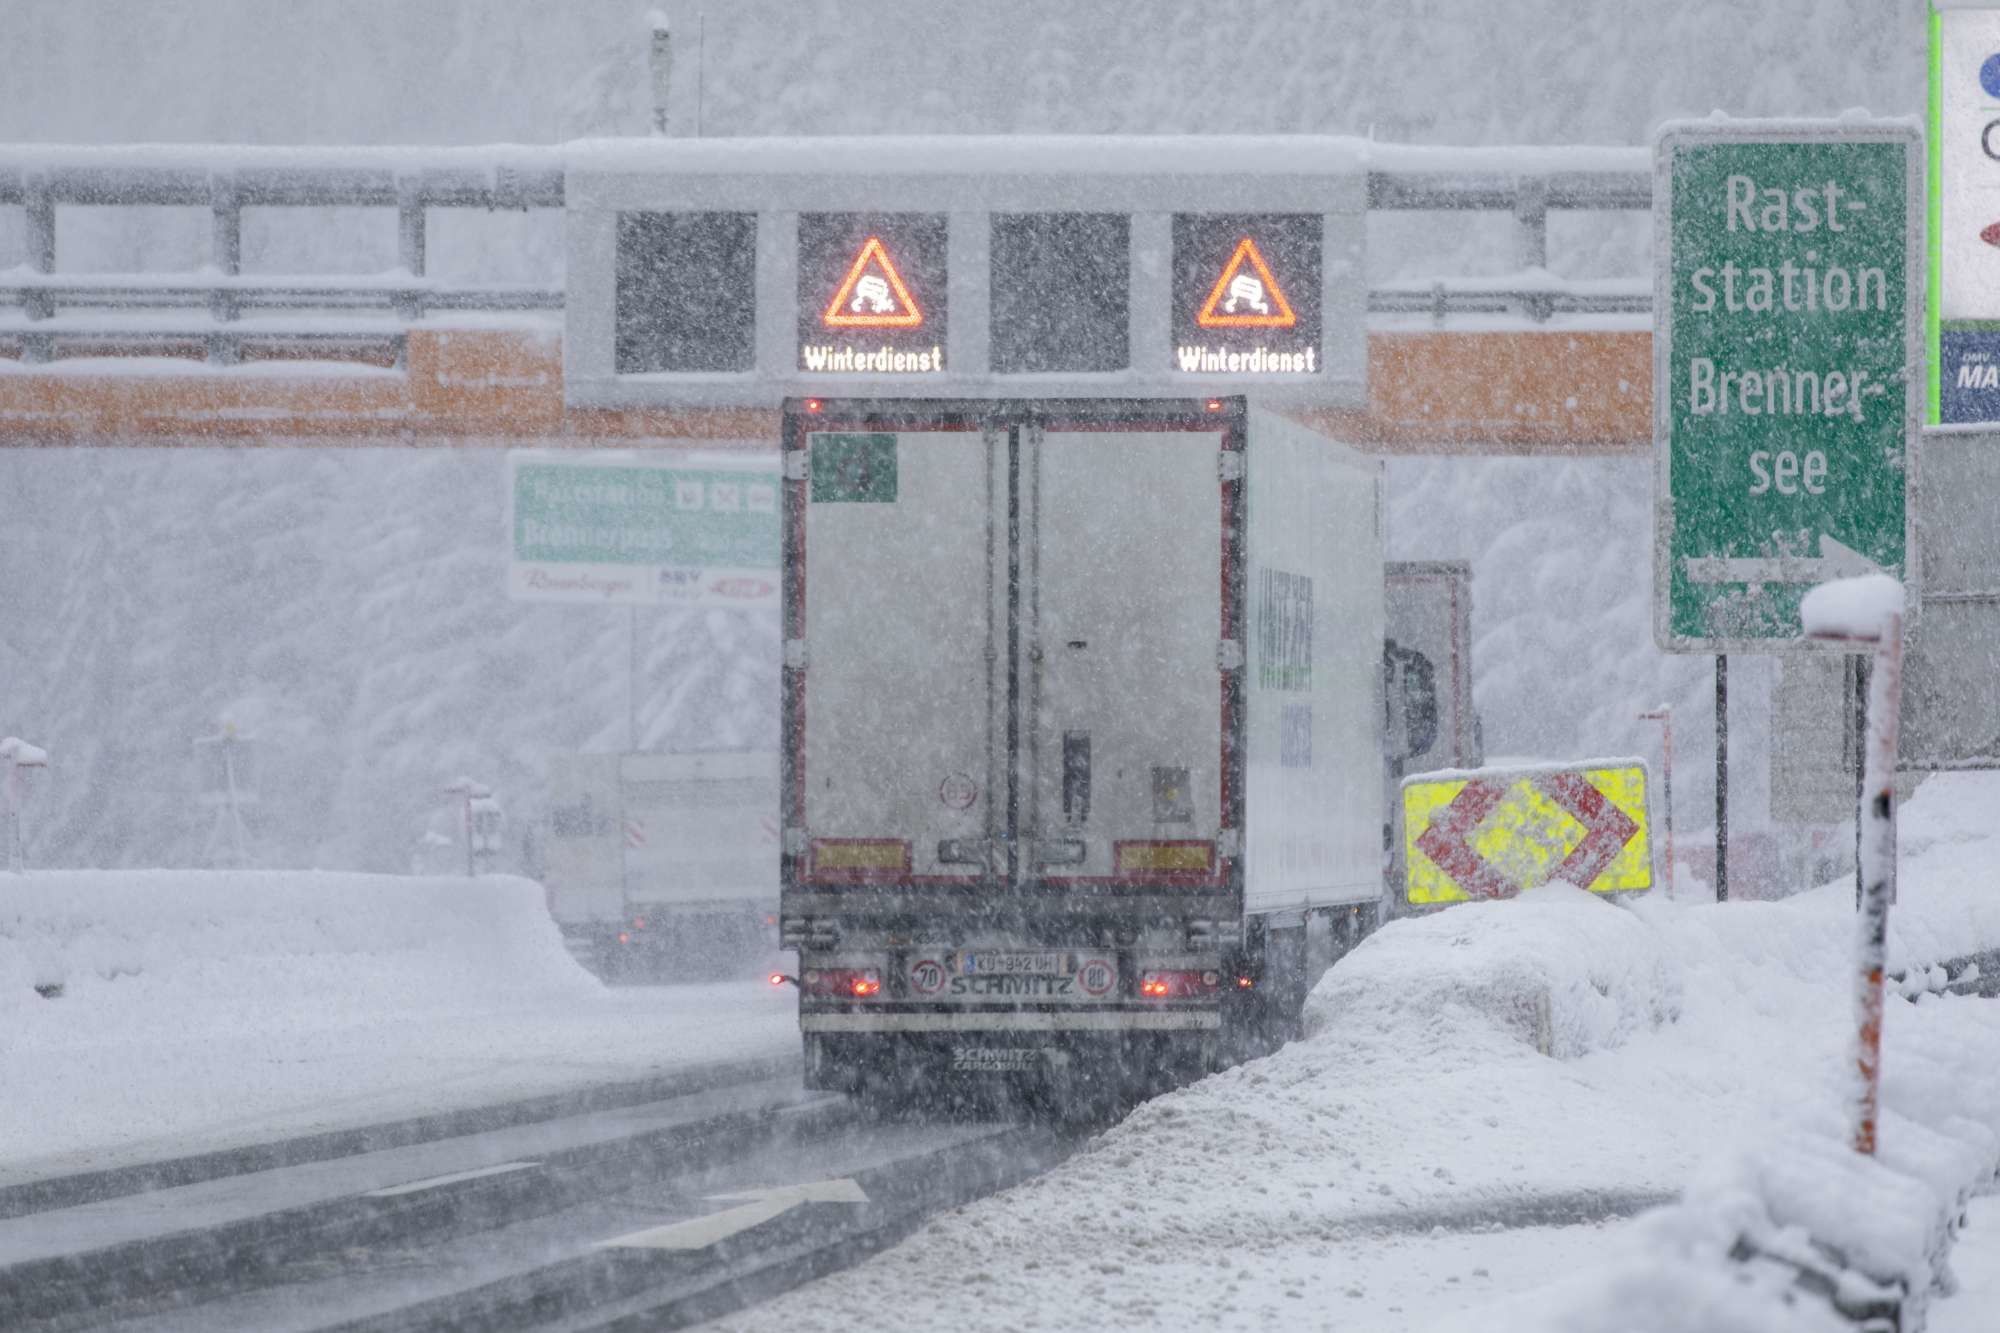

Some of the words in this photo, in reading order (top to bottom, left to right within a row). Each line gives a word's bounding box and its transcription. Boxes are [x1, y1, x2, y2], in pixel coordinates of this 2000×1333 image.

[1727, 175, 1867, 232] Rast-
[1690, 251, 1887, 312] station
[804, 345, 941, 371] Winterdienst
[1178, 346, 1315, 372] Winterdienst
[1691, 357, 1885, 416] Brenner-
[1750, 450, 1828, 495] see
[920, 967, 938, 988] 70
